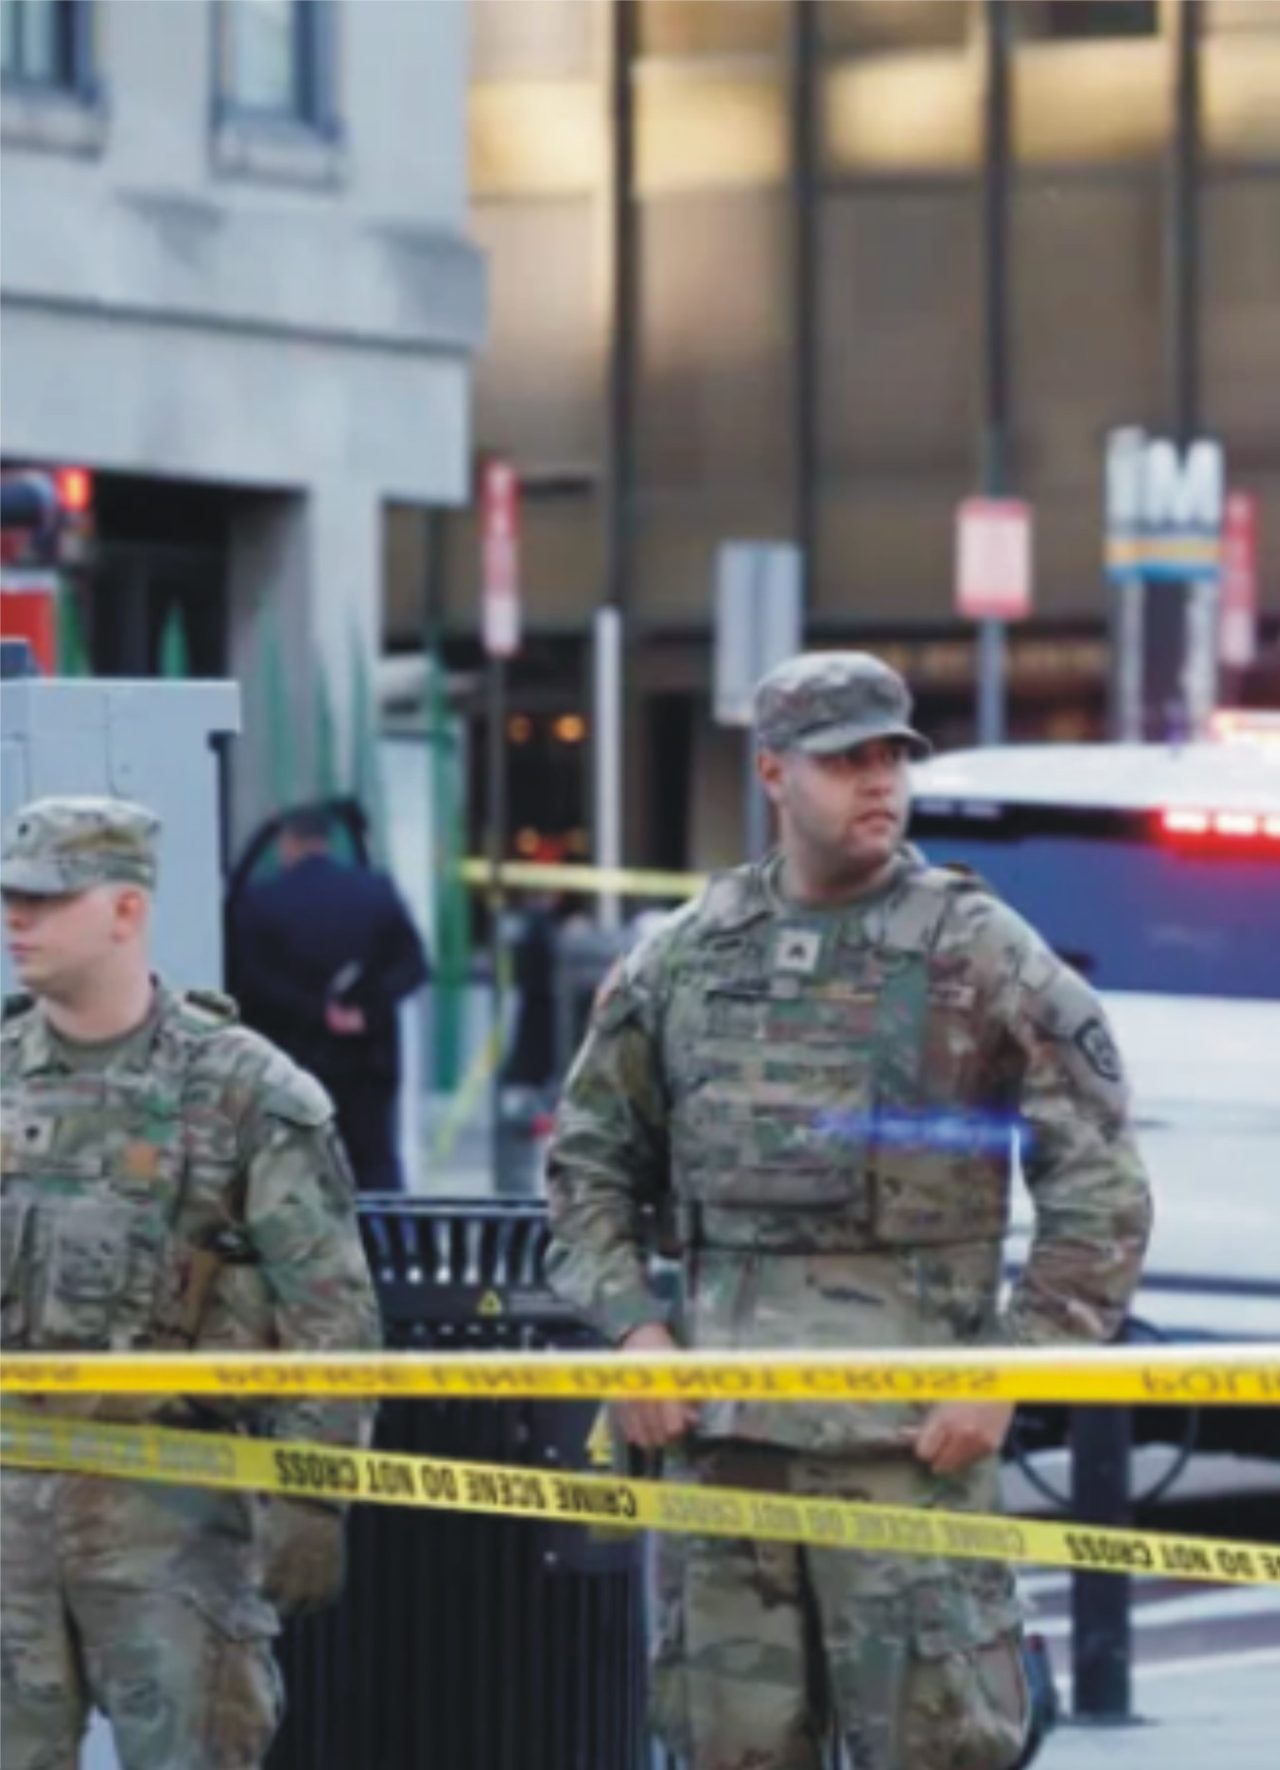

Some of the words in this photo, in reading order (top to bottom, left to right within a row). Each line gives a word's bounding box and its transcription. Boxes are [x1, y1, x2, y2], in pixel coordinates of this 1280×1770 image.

[274, 1449, 360, 1492] CROSS
[365, 1458, 416, 1498] NOT
[420, 1463, 459, 1501] DO
[464, 1468, 547, 1510] SCENE
[553, 1477, 638, 1518] CRIME
[1064, 1531, 1154, 1568] CROSS
[1160, 1540, 1211, 1573] NOT
[1214, 1547, 1257, 1578] DO
